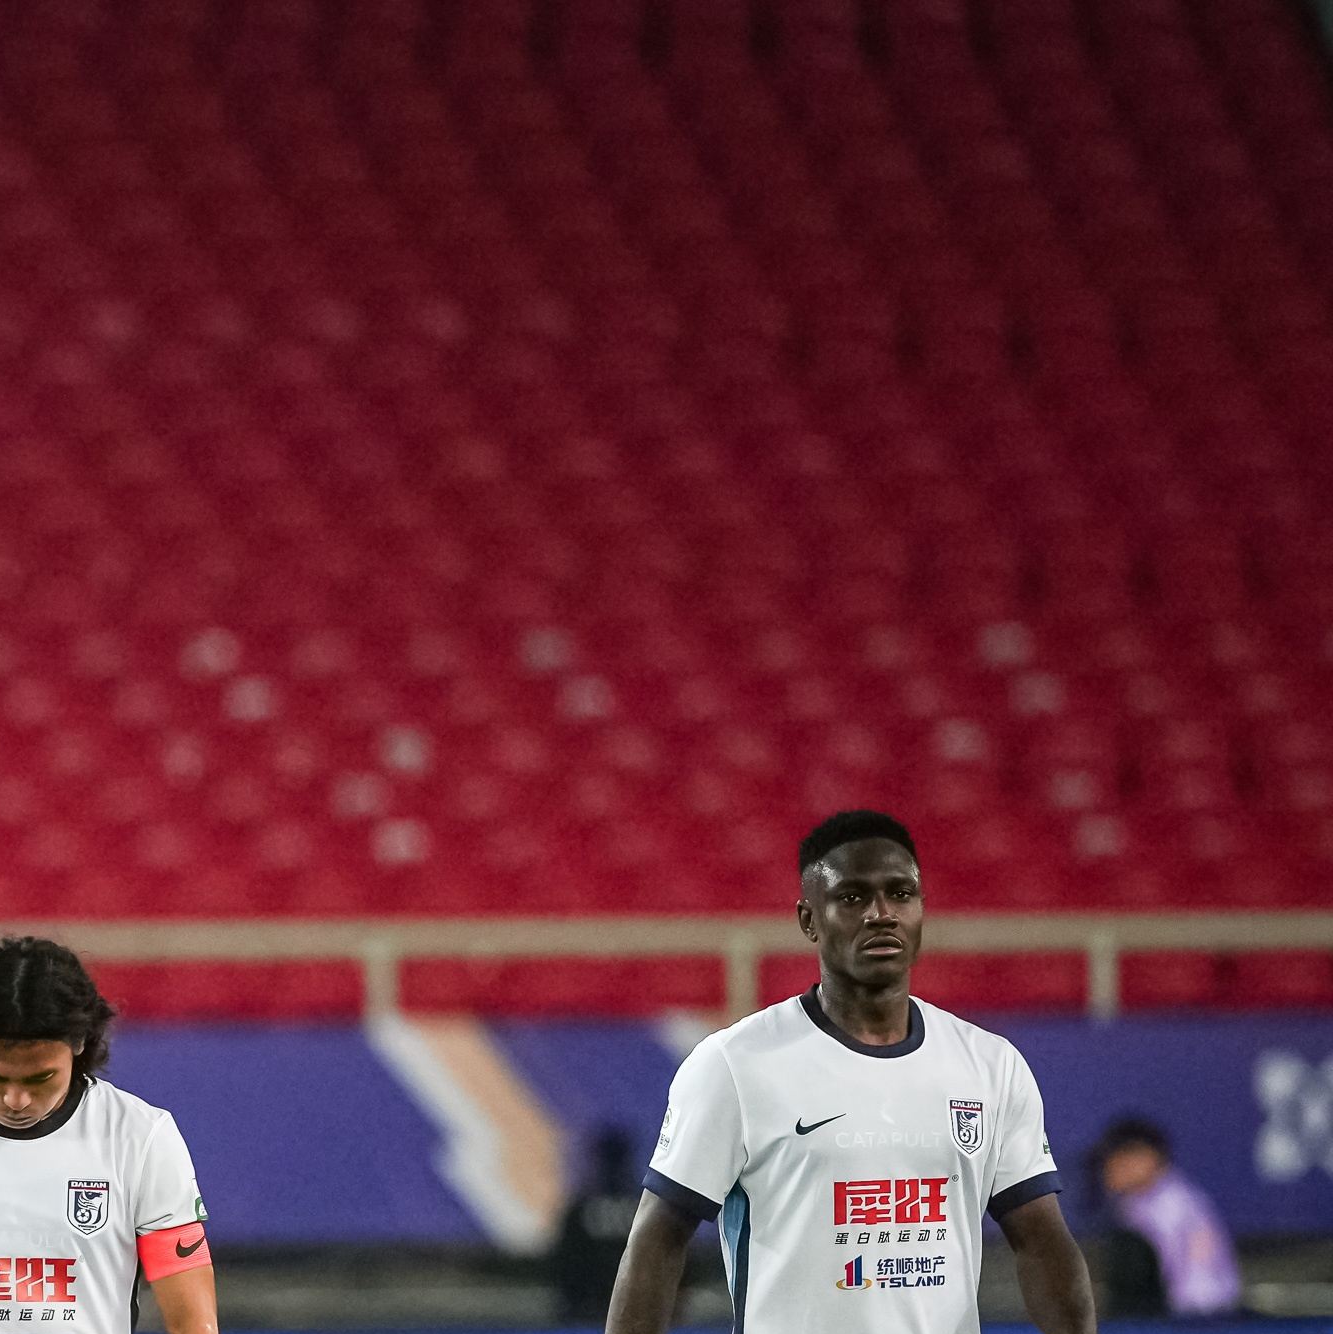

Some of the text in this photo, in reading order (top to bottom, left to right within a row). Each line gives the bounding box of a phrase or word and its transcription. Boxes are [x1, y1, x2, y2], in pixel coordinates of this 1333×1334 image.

[952, 1101, 981, 1109] DALIAN
[71, 1181, 107, 1189] DALIAN
[834, 1177, 949, 1226] 犀旺
[835, 1228, 947, 1245] 蛋白肽运动饮
[876, 1255, 946, 1276] 统顺地产
[876, 1275, 946, 1289] TSLAND
